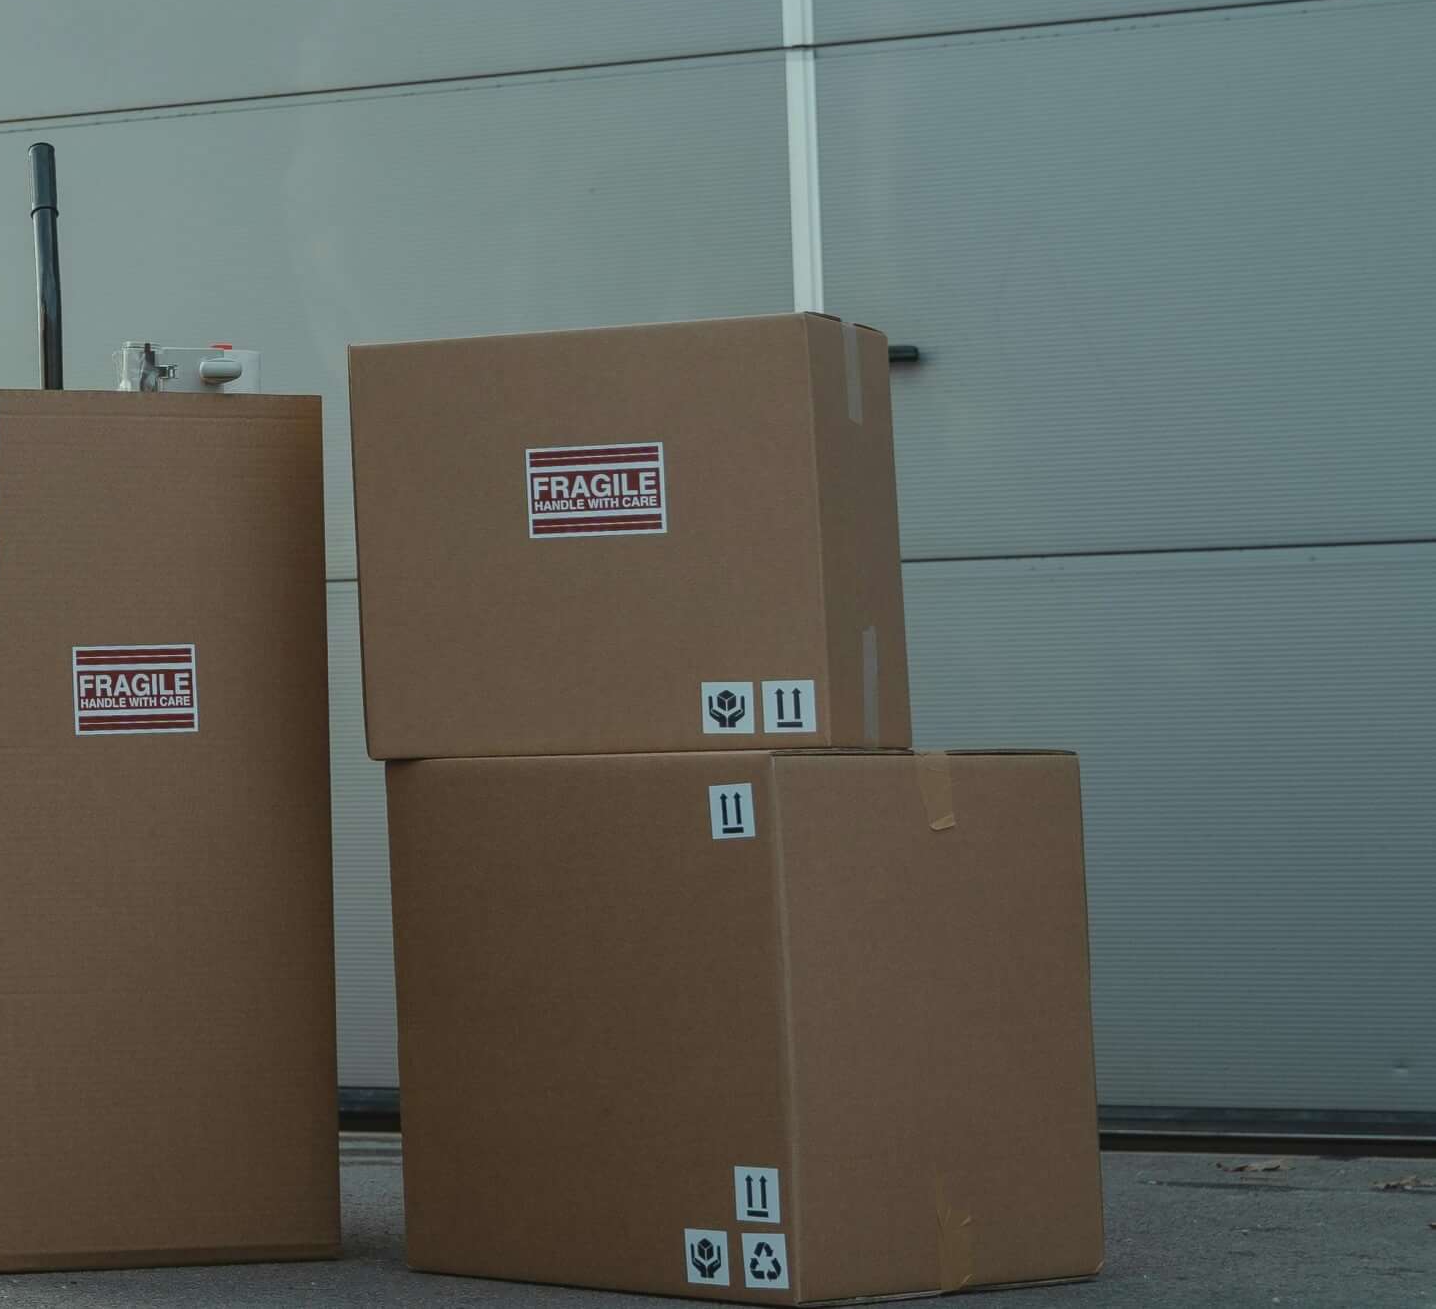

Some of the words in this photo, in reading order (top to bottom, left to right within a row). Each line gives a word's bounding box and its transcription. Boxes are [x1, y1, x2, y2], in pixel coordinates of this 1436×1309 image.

[532, 472, 657, 499] FRAGILE
[534, 499, 585, 511] HANDLE
[587, 497, 619, 509] WITH
[622, 496, 657, 507] CARE
[79, 673, 191, 697] FRAGILE
[80, 697, 126, 708] HANDLE
[129, 697, 157, 707] WITH
[159, 696, 190, 706] CARE
